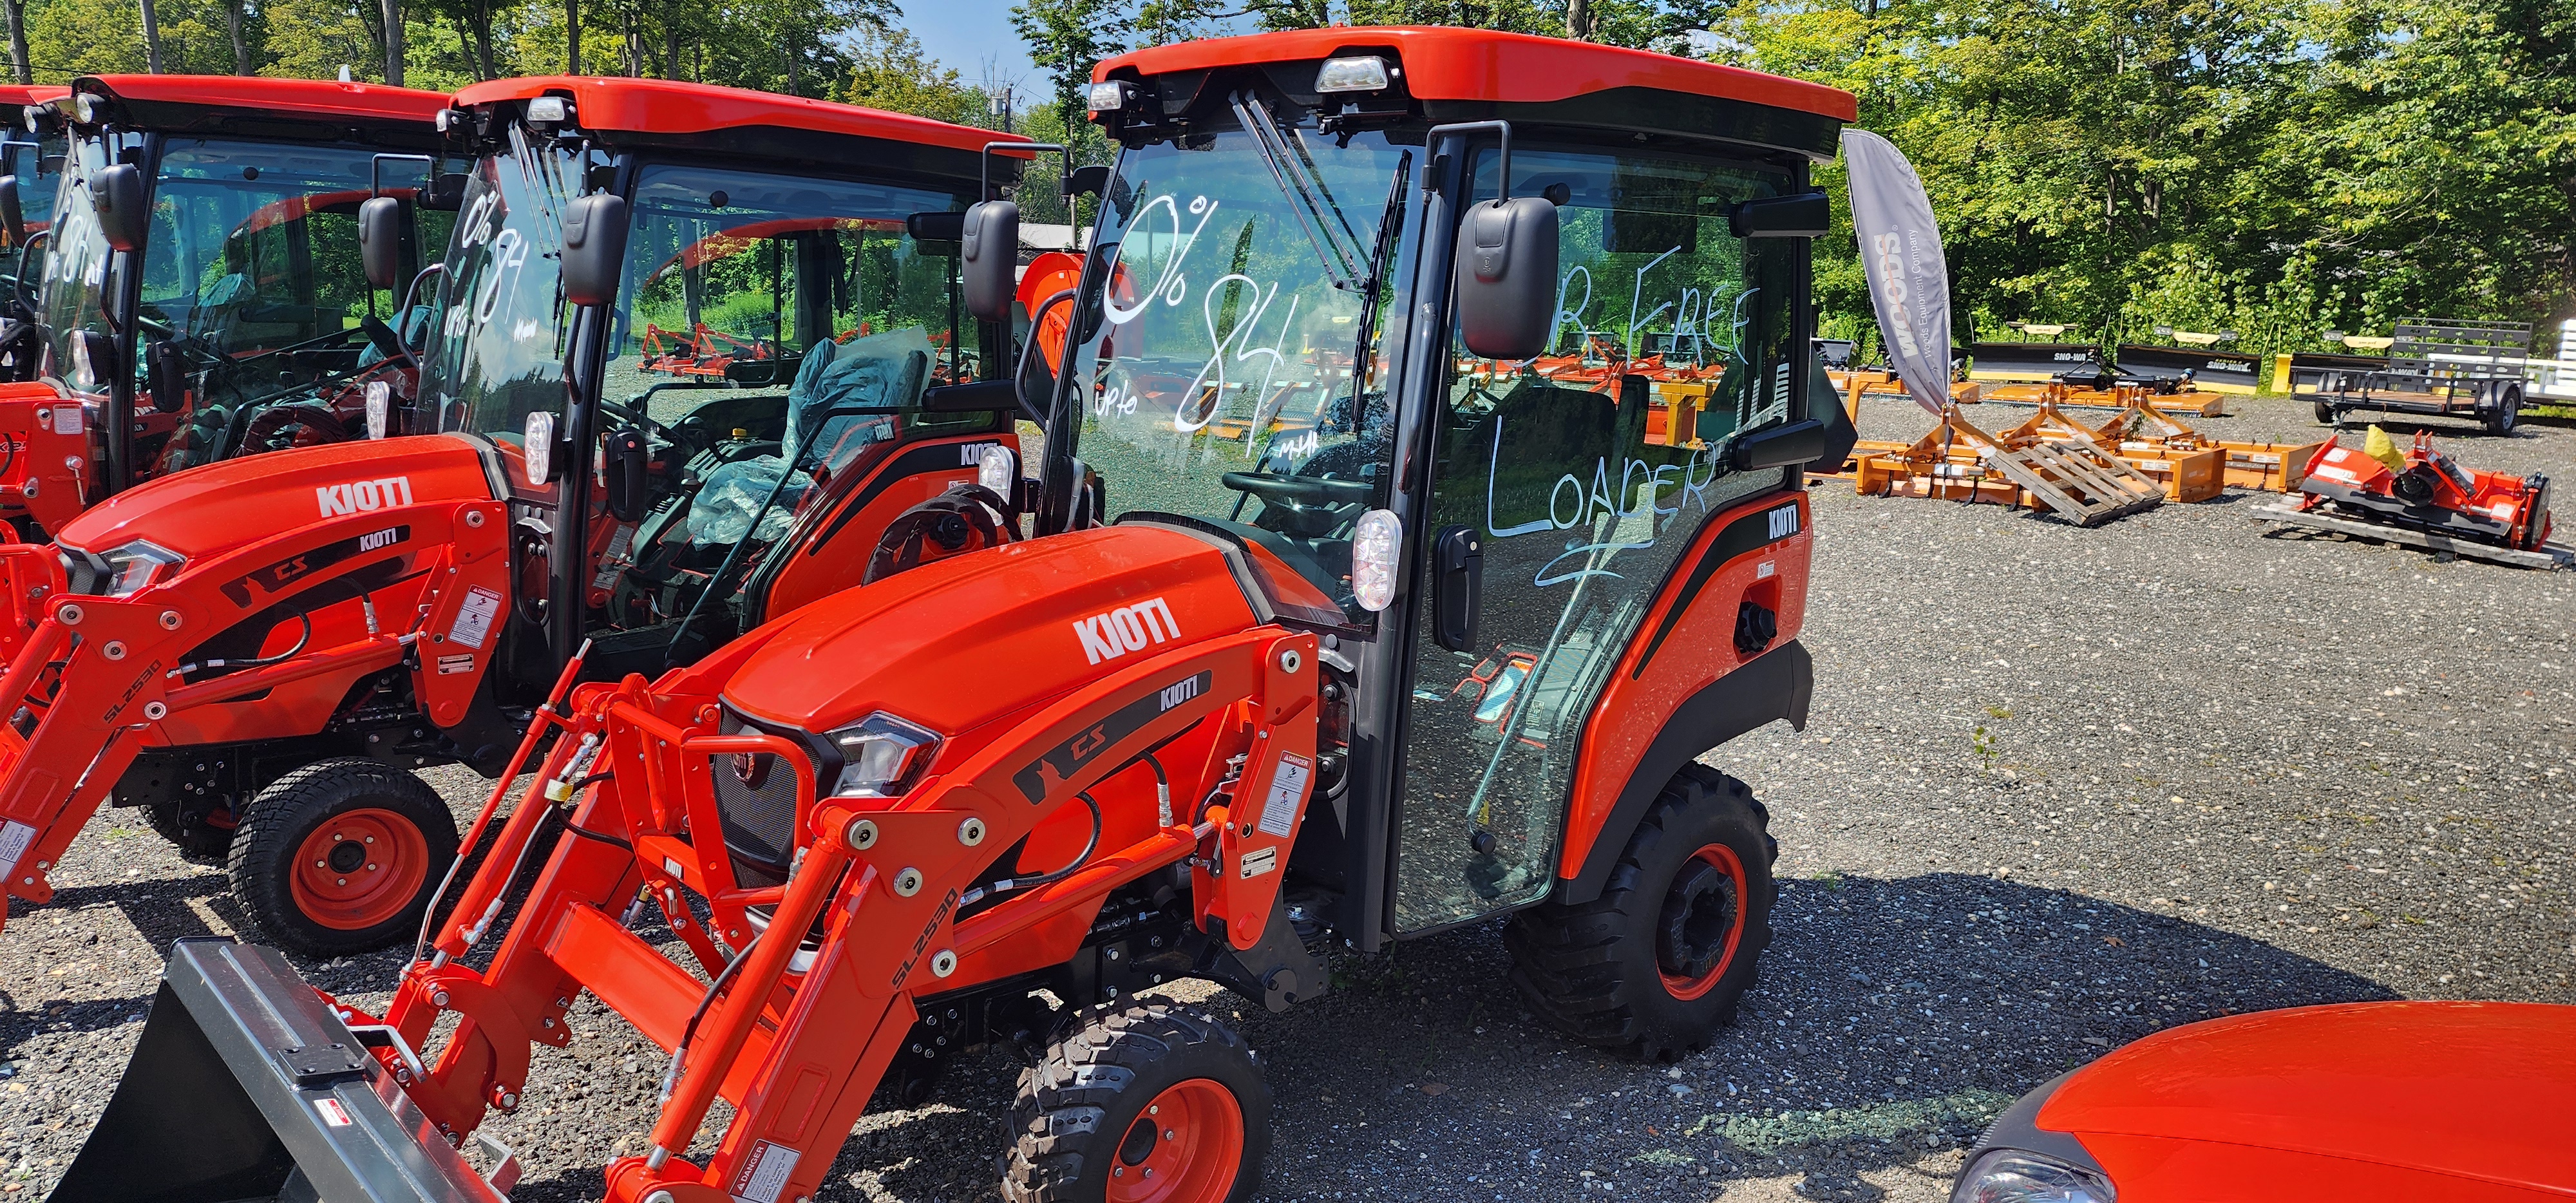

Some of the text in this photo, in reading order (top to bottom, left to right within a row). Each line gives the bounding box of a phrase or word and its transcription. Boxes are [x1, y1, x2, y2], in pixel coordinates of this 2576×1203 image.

[462, 189, 500, 249] 0%
[480, 228, 529, 325] 84
[1104, 194, 1219, 325] 0%
[1626, 245, 1761, 370] FREE
[1874, 232, 1919, 358] WOODS
[1908, 229, 1931, 359] Woods Equipment Company
[1174, 274, 1299, 459] 84
[961, 442, 998, 466] KIO
[1488, 415, 1716, 537] LOADER
[316, 476, 413, 518] KIOTI
[359, 527, 397, 552] KIOTI
[1768, 504, 1797, 540] KIOTI
[274, 556, 308, 580] CS
[477, 589, 500, 600] DANGER
[1072, 596, 1181, 666] KIOTI
[103, 658, 163, 725] SL2530
[1160, 675, 1198, 712] KIOTI
[1070, 723, 1106, 761] CS
[1288, 755, 1309, 767] DANGER
[665, 857, 682, 878] KIOTI
[891, 887, 958, 990] SL2530
[741, 1145, 764, 1182] DANGER
[772, 1161, 783, 1178] comply
[773, 1169, 782, 1182] death
